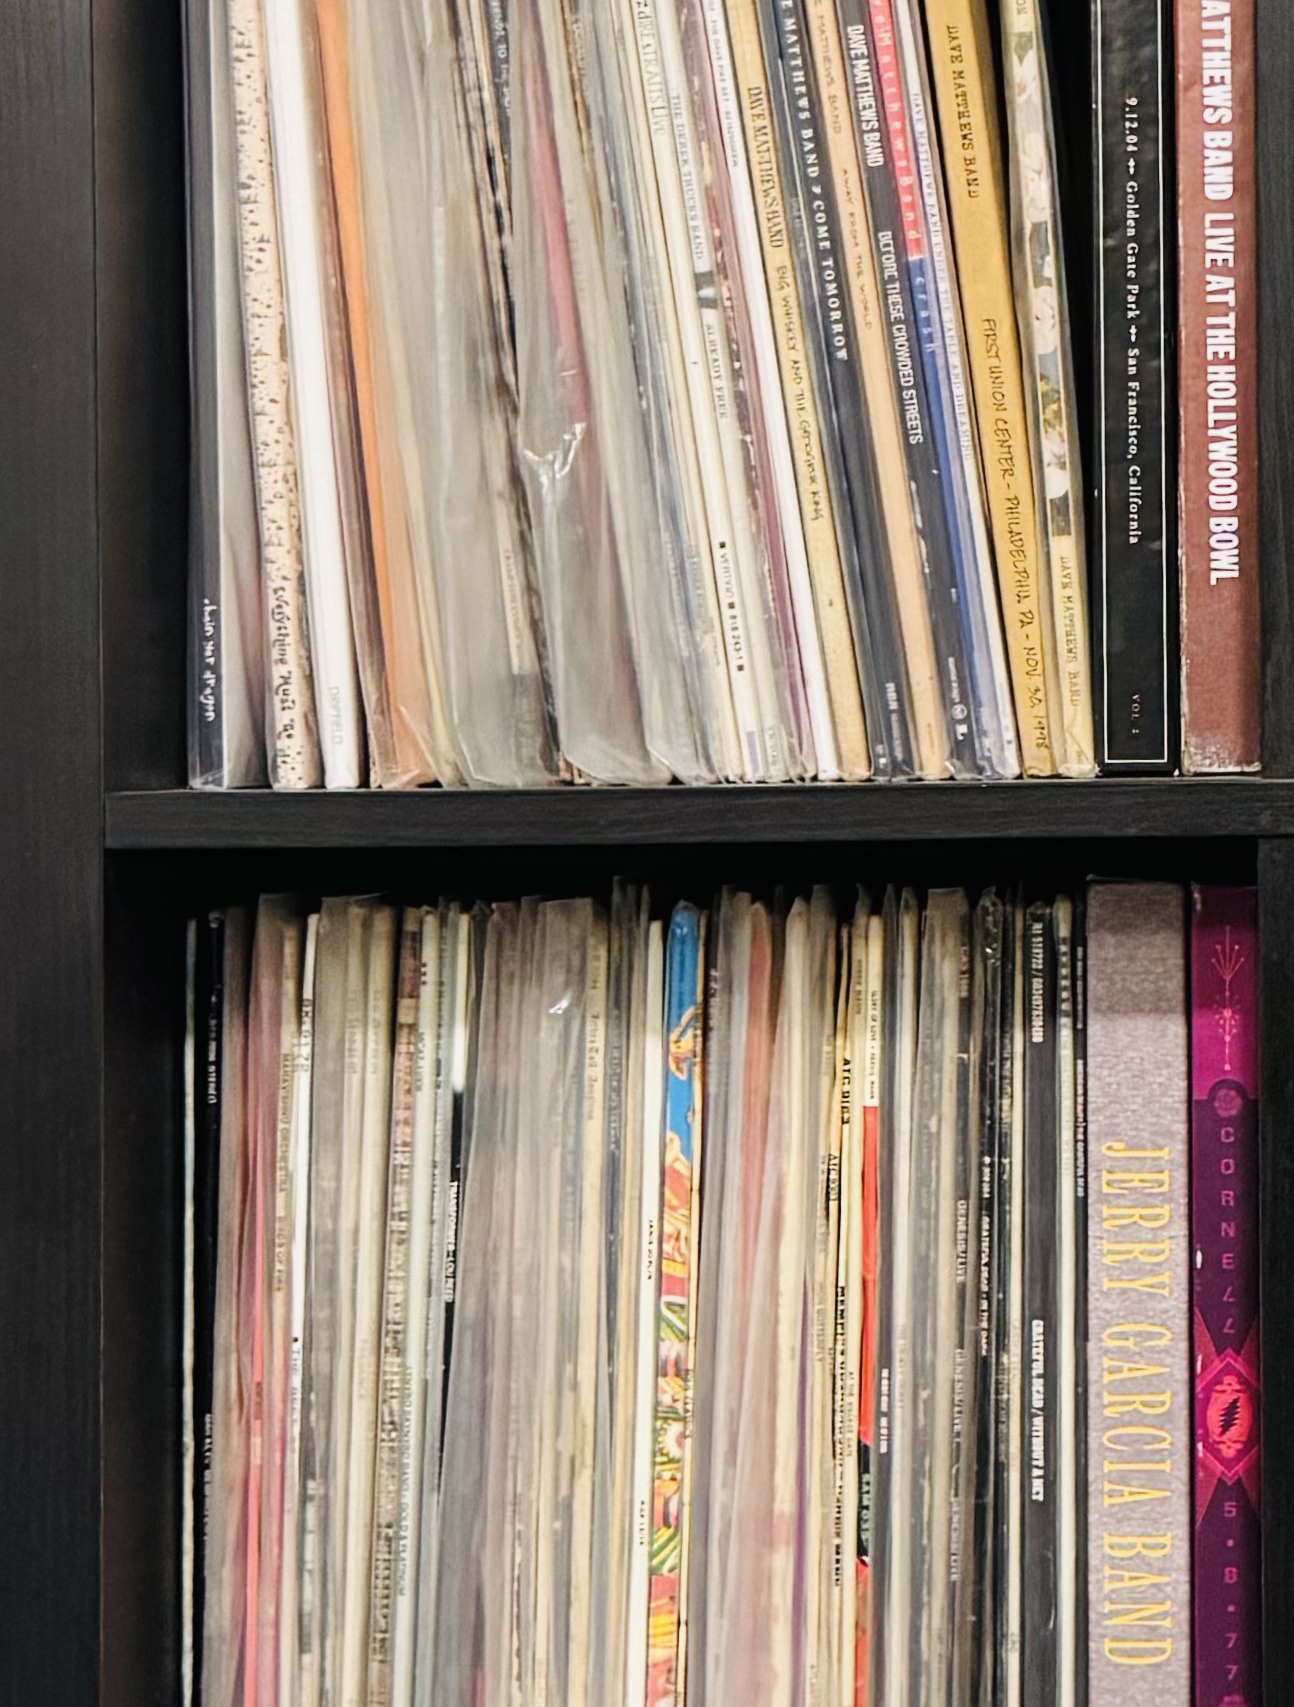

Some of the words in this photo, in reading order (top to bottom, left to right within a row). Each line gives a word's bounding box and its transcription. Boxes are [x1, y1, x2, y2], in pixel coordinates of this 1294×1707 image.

[815, 14, 836, 87] MATTHEWS
[847, 24, 868, 58] DAVE
[945, 24, 963, 64] DAVE
[783, 17, 811, 120] MATTHEWS
[671, 93, 685, 120] THE
[747, 85, 767, 121] DAVE
[828, 94, 844, 134] BAND
[852, 58, 878, 130] MATTHEWS
[951, 69, 975, 151] MATTHEWS
[675, 123, 692, 167] DEREK
[1126, 97, 1138, 151] 9.12.04
[801, 128, 821, 178] BAND
[863, 131, 884, 167] BAND
[1204, 131, 1234, 200] BAND
[682, 171, 700, 221] TRUCKS
[840, 167, 855, 204] AWAY
[963, 155, 982, 199] BAND
[765, 209, 785, 248] BAND
[812, 199, 832, 250] COME
[847, 211, 861, 247] FROM
[1126, 180, 1139, 236] Golden
[691, 224, 706, 260] BAND
[878, 230, 899, 280] BEFORE
[1126, 243, 1139, 277] Gate
[1205, 213, 1236, 268] LIVE
[775, 265, 791, 291] BIG
[854, 254, 867, 278] THE
[821, 257, 849, 361] TOMORROW
[859, 284, 875, 329] WORLD
[886, 282, 905, 321] THESE
[1127, 284, 1139, 319] Park
[1206, 274, 1236, 306] AT
[780, 295, 800, 352] WHISKEY
[981, 317, 1002, 362] FIRST
[1206, 312, 1237, 360] THE
[790, 357, 805, 385] AND
[892, 324, 914, 387] CROWDED
[1127, 347, 1140, 374] San
[715, 386, 729, 419] FREE
[794, 388, 809, 417] THE
[988, 364, 1008, 412] UNION
[902, 389, 923, 444] STREETS
[1126, 382, 1141, 459] Francisco,
[1207, 365, 1239, 510] HOLLYWOOD
[993, 416, 1018, 481] CENTER
[807, 490, 825, 521] KING
[1128, 465, 1142, 544] California
[1060, 555, 1073, 589] DAVE
[1210, 516, 1241, 584] BOWL
[1018, 609, 1035, 629] PA
[1062, 594, 1078, 663] MATTHEWS
[200, 670, 217, 721] dragon
[1068, 670, 1081, 707] BAND
[1131, 693, 1141, 720] VOL
[956, 1200, 968, 1283] GENESIS/LIVE
[1100, 1140, 1174, 1299] JERRY
[1031, 1319, 1044, 1376] GRATEFUL
[1031, 1378, 1044, 1408] DEAD
[1099, 1321, 1174, 1508] GARCIA
[1031, 1416, 1044, 1464] WITHOUT
[1031, 1467, 1044, 1477] A
[1031, 1478, 1044, 1501] NET
[1099, 1533, 1174, 1666] BAND
